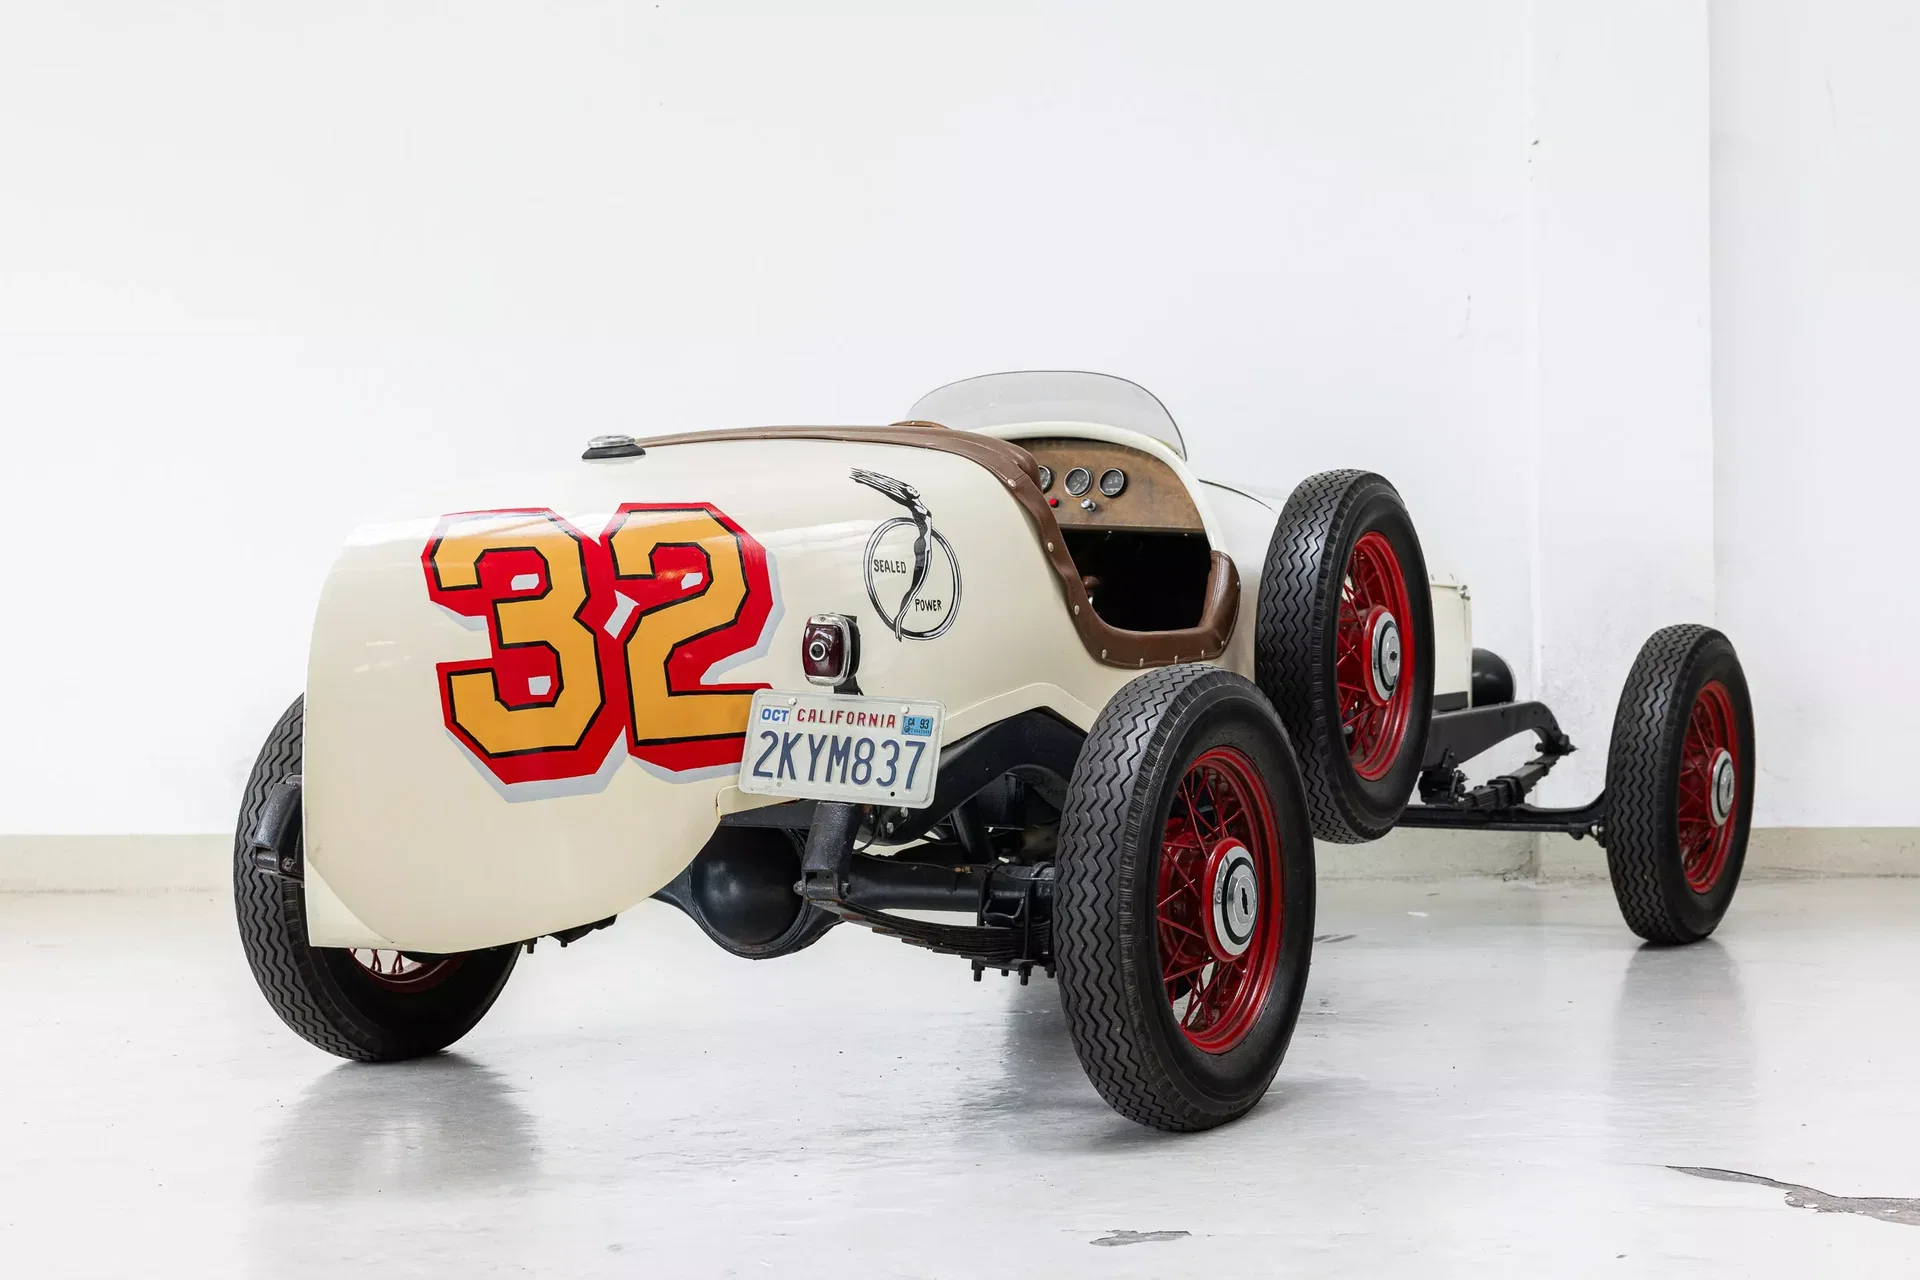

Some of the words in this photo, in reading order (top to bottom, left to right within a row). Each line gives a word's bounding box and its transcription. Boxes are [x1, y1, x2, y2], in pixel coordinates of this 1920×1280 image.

[873, 559, 907, 574] SEALED
[915, 598, 943, 612] POWER
[421, 502, 785, 803] 32
[761, 708, 790, 722] OCT
[797, 708, 896, 728] CALIFORNIA
[920, 718, 930, 729] 93
[752, 730, 926, 790] 2KYM837
